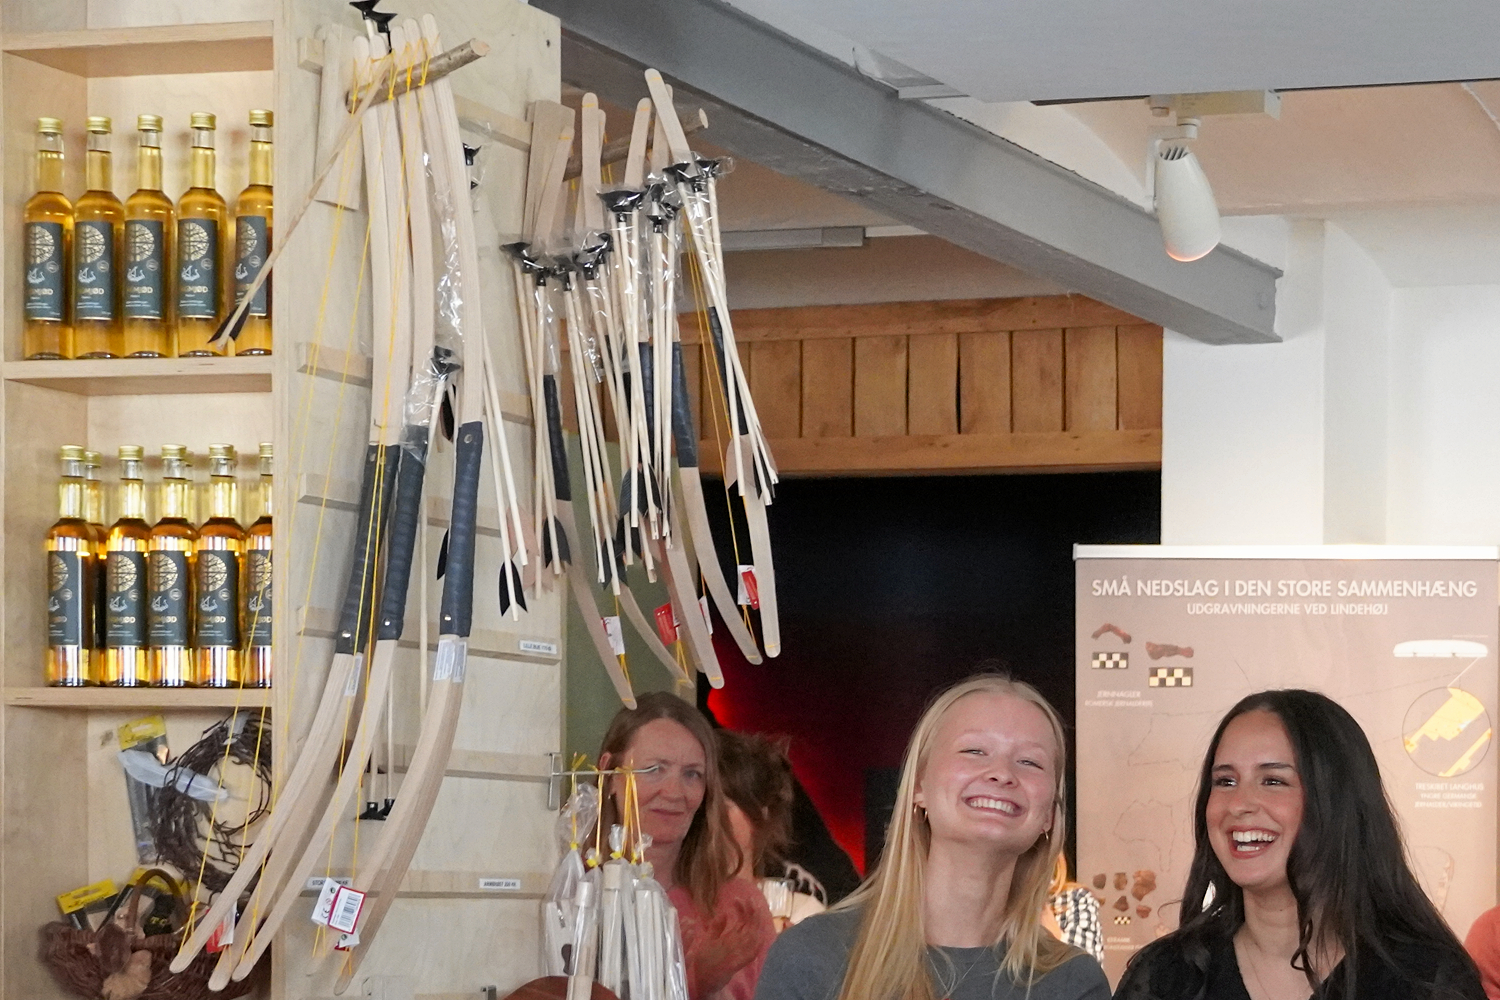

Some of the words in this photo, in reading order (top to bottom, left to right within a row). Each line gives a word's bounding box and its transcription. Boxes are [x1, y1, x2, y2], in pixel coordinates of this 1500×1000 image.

[1091, 575, 1131, 597] SMÅ
[1136, 579, 1219, 597] NEDSLAG
[1224, 580, 1229, 597] I
[1235, 580, 1272, 597] DEN
[1277, 580, 1332, 597] STORE
[1337, 580, 1478, 598] SAMMENHÆNG
[1187, 603, 1300, 615] UDGRAVNINGERNE
[1304, 603, 1328, 615] VED
[1330, 603, 1389, 615] LINDEHØJ
